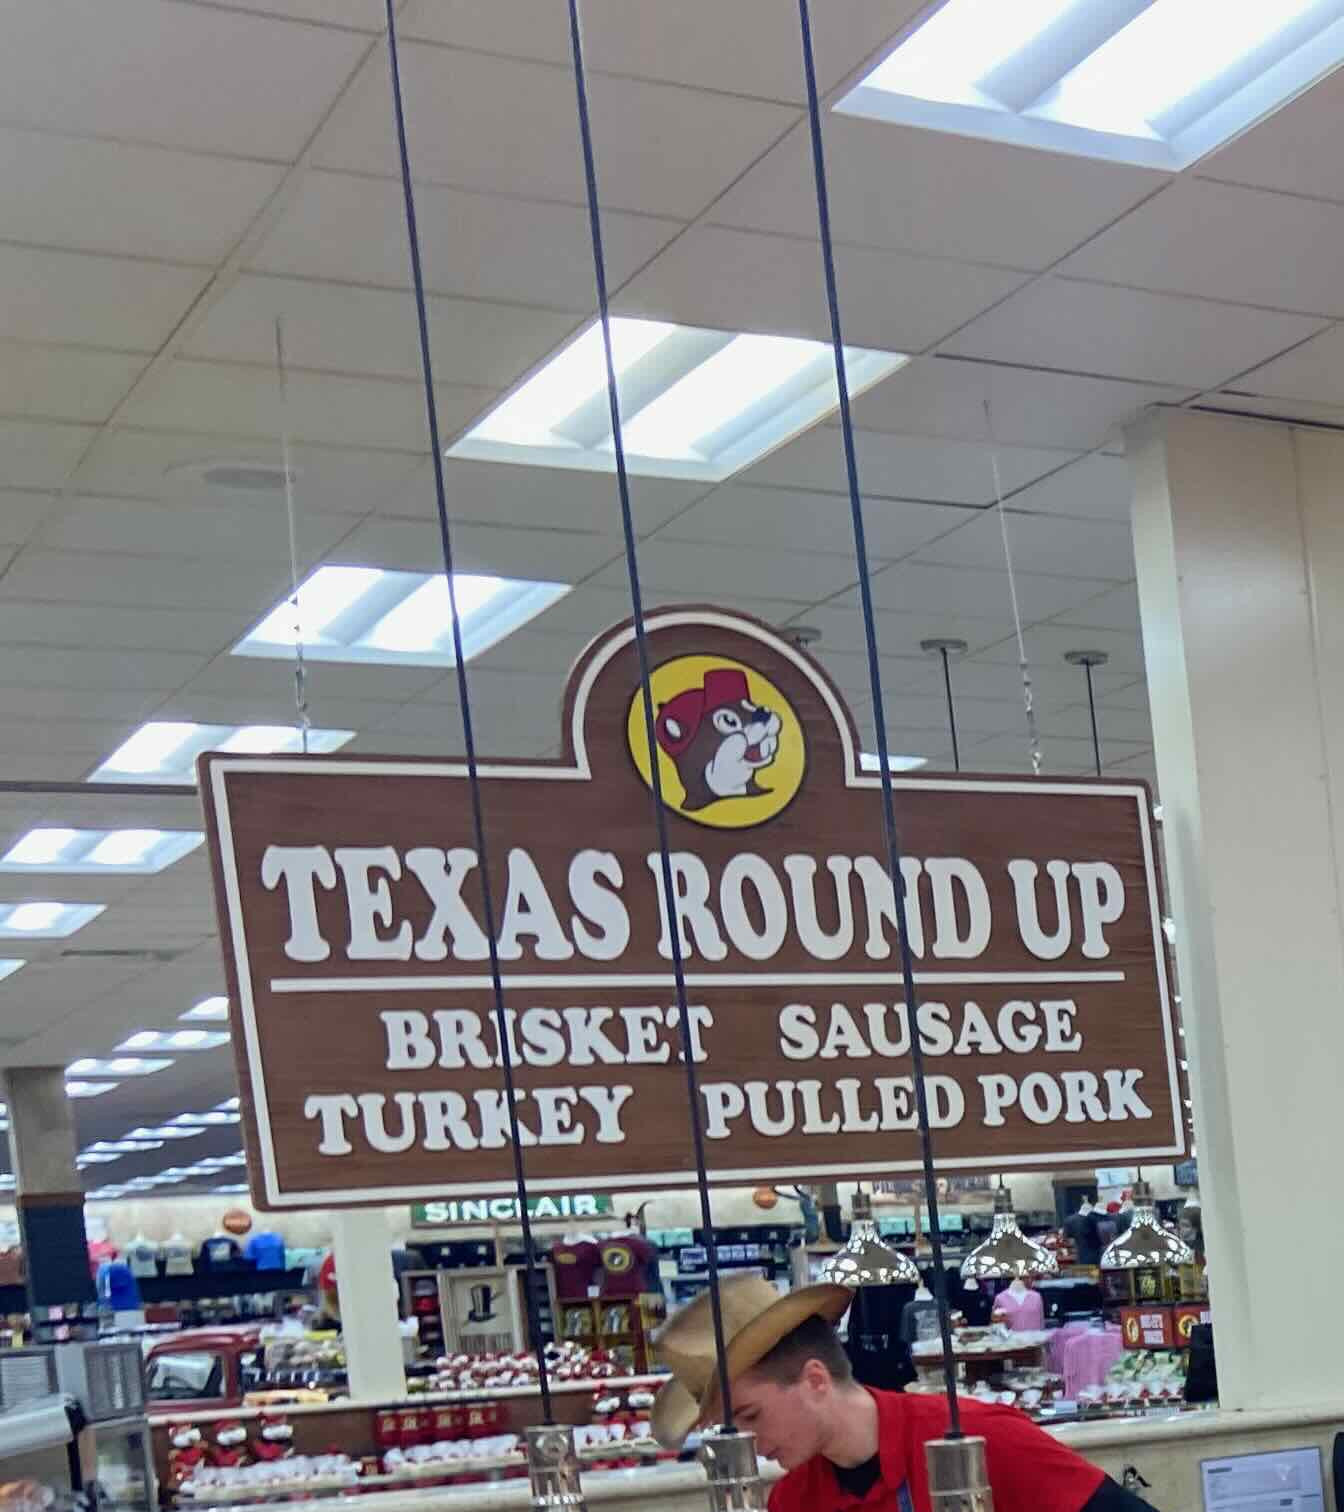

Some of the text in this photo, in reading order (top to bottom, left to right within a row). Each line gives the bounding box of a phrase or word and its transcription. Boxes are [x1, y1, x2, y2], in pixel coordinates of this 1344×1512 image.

[261, 845, 1126, 961] TEXAS ROUND UP
[379, 999, 1082, 1070] BRISKET SAUSAGE
[304, 1068, 1153, 1156] TURKEY PULLED PORK
[424, 1195, 601, 1223] SINCLAIR
